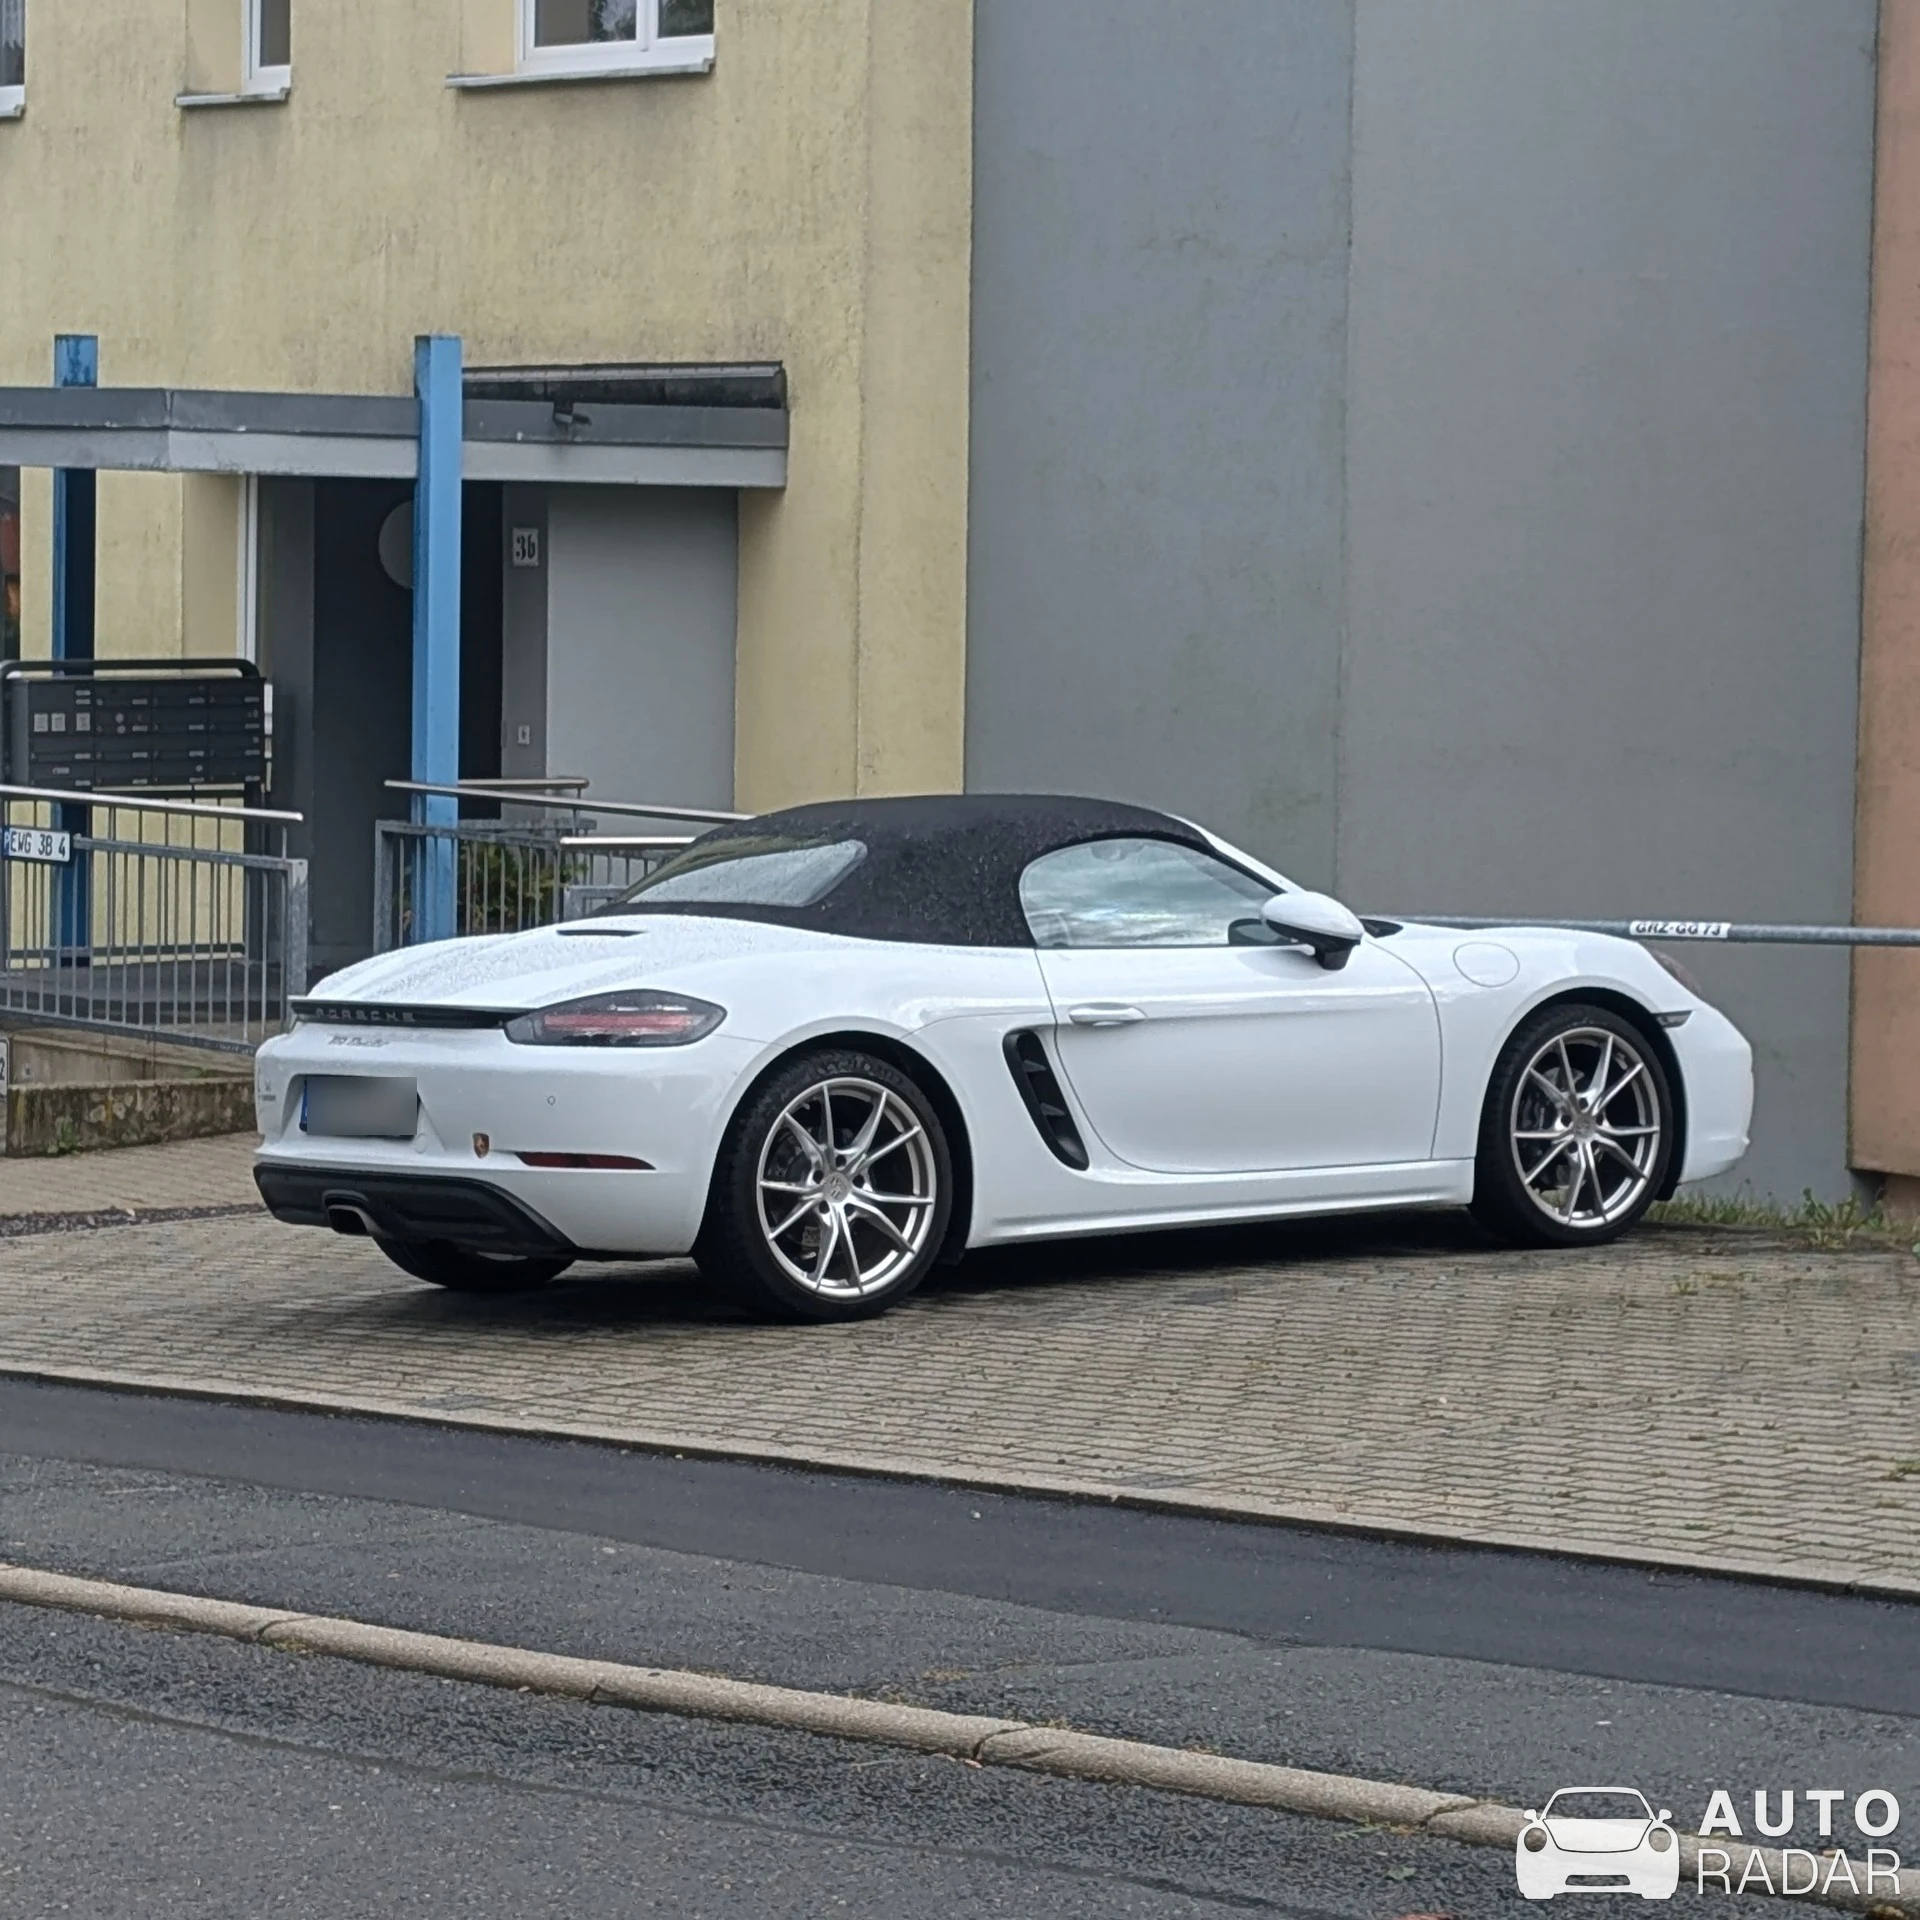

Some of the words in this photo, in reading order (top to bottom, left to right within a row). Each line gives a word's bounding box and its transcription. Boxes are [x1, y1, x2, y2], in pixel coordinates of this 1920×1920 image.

[10, 831, 32, 854] EWG
[38, 834, 53, 856] 3B
[58, 837, 66, 858] 4
